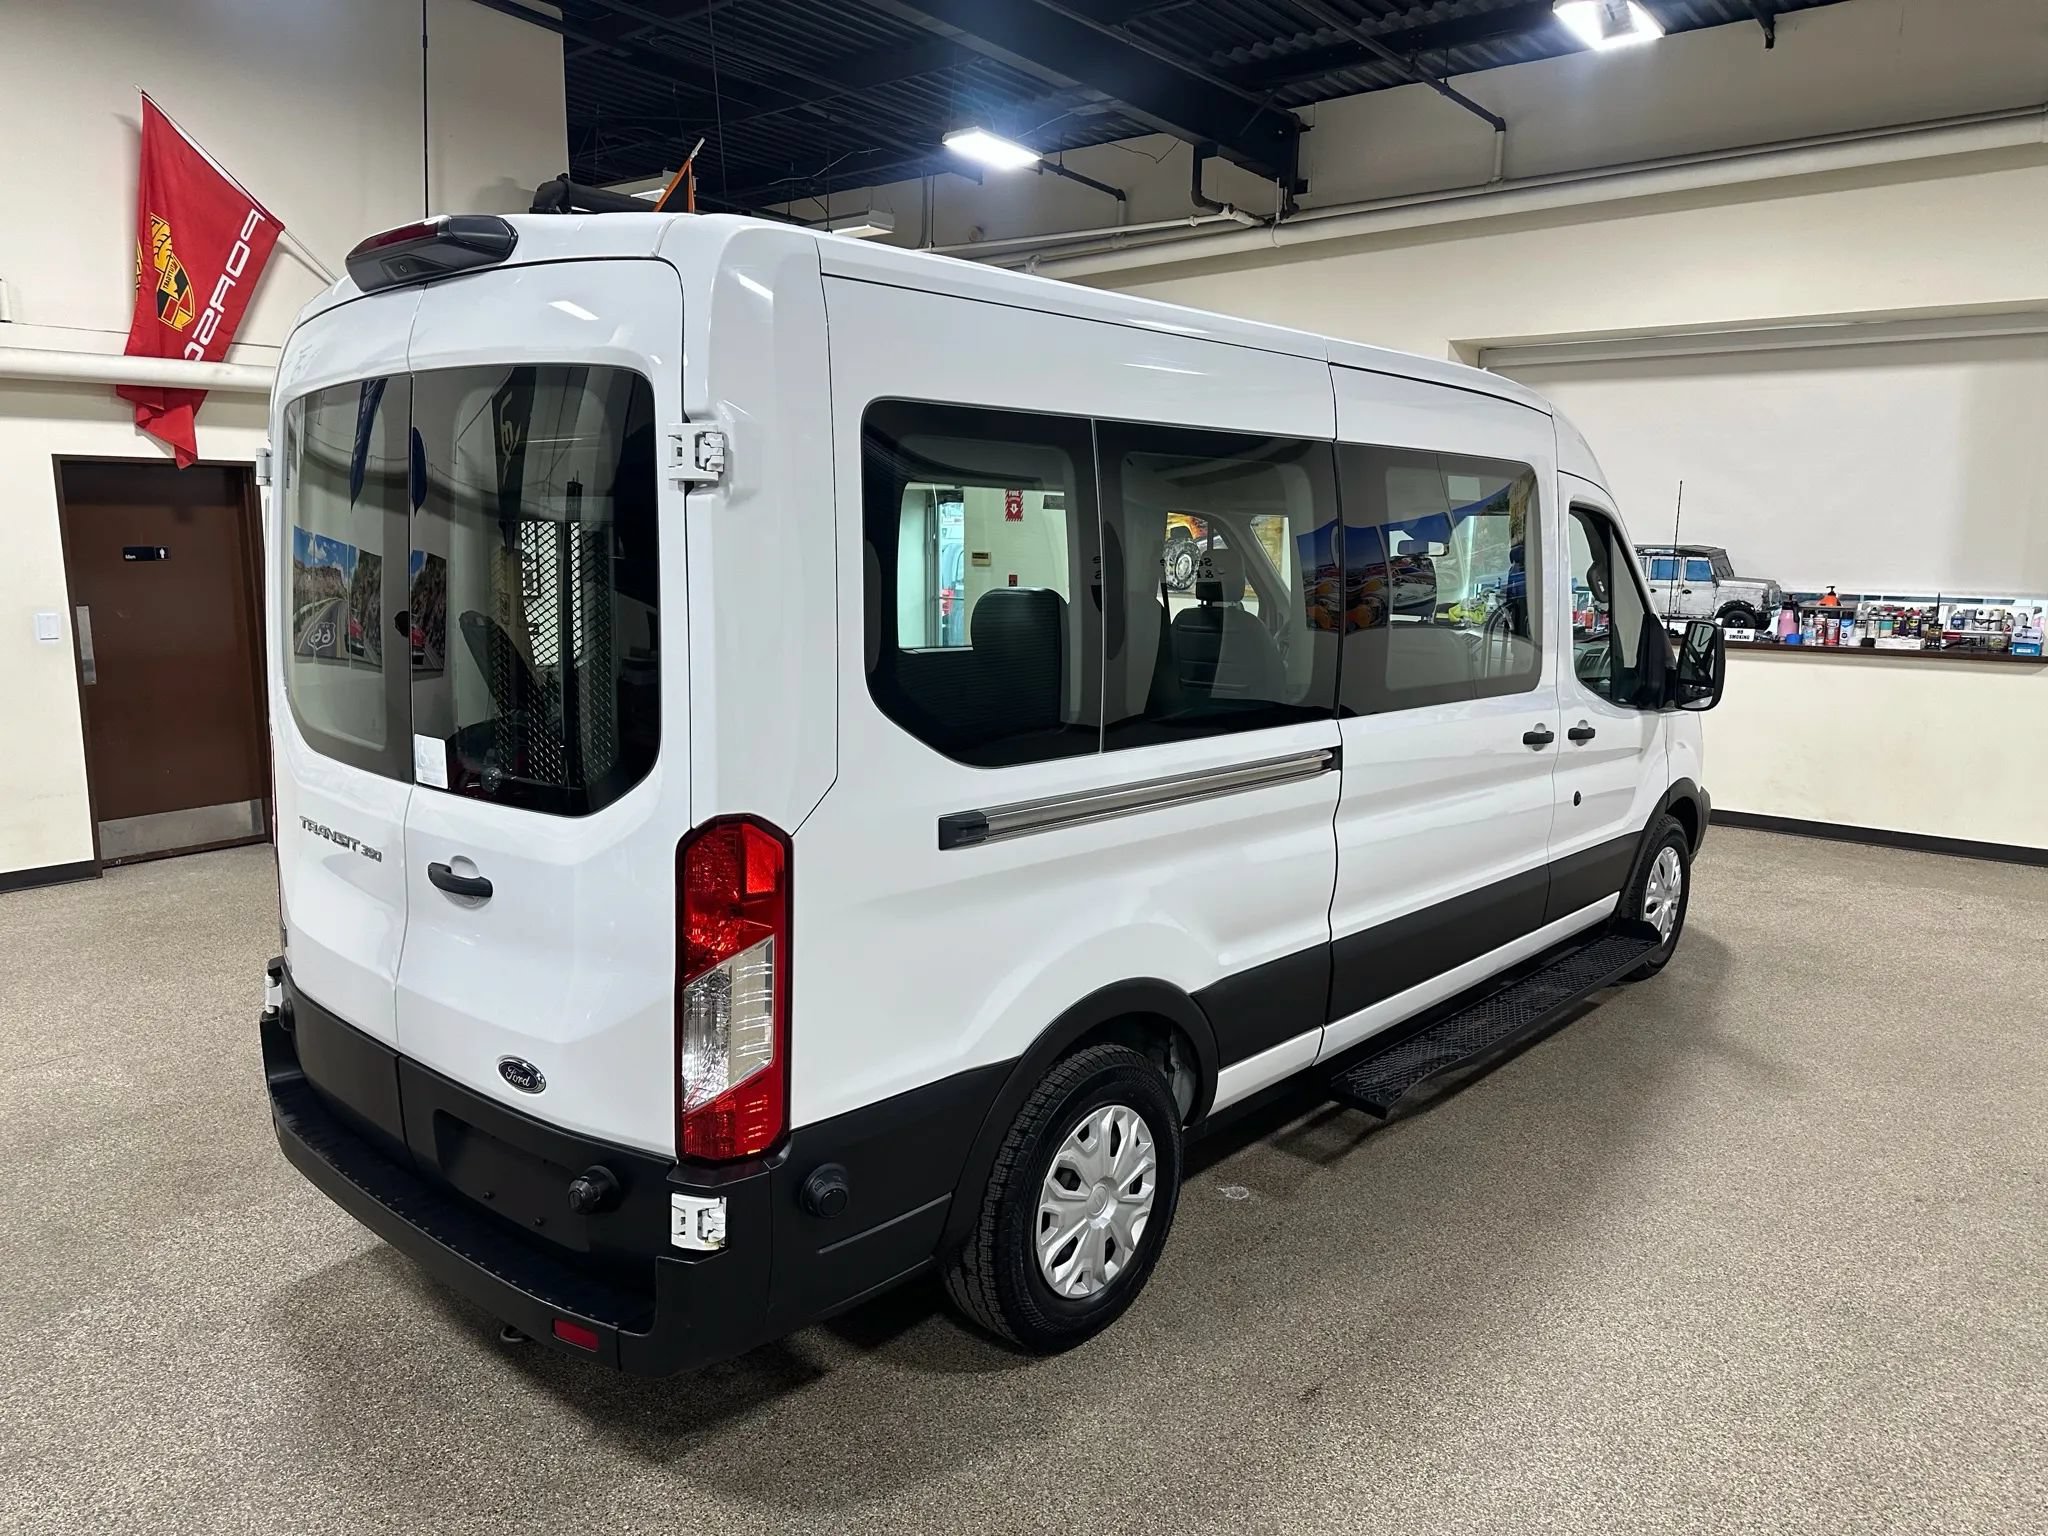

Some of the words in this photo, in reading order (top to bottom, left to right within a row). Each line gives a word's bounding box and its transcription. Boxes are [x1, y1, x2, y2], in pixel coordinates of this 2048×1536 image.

[299, 815, 361, 852] TRANSIT
[361, 845, 383, 862] 350
[505, 1065, 531, 1087] Ford
